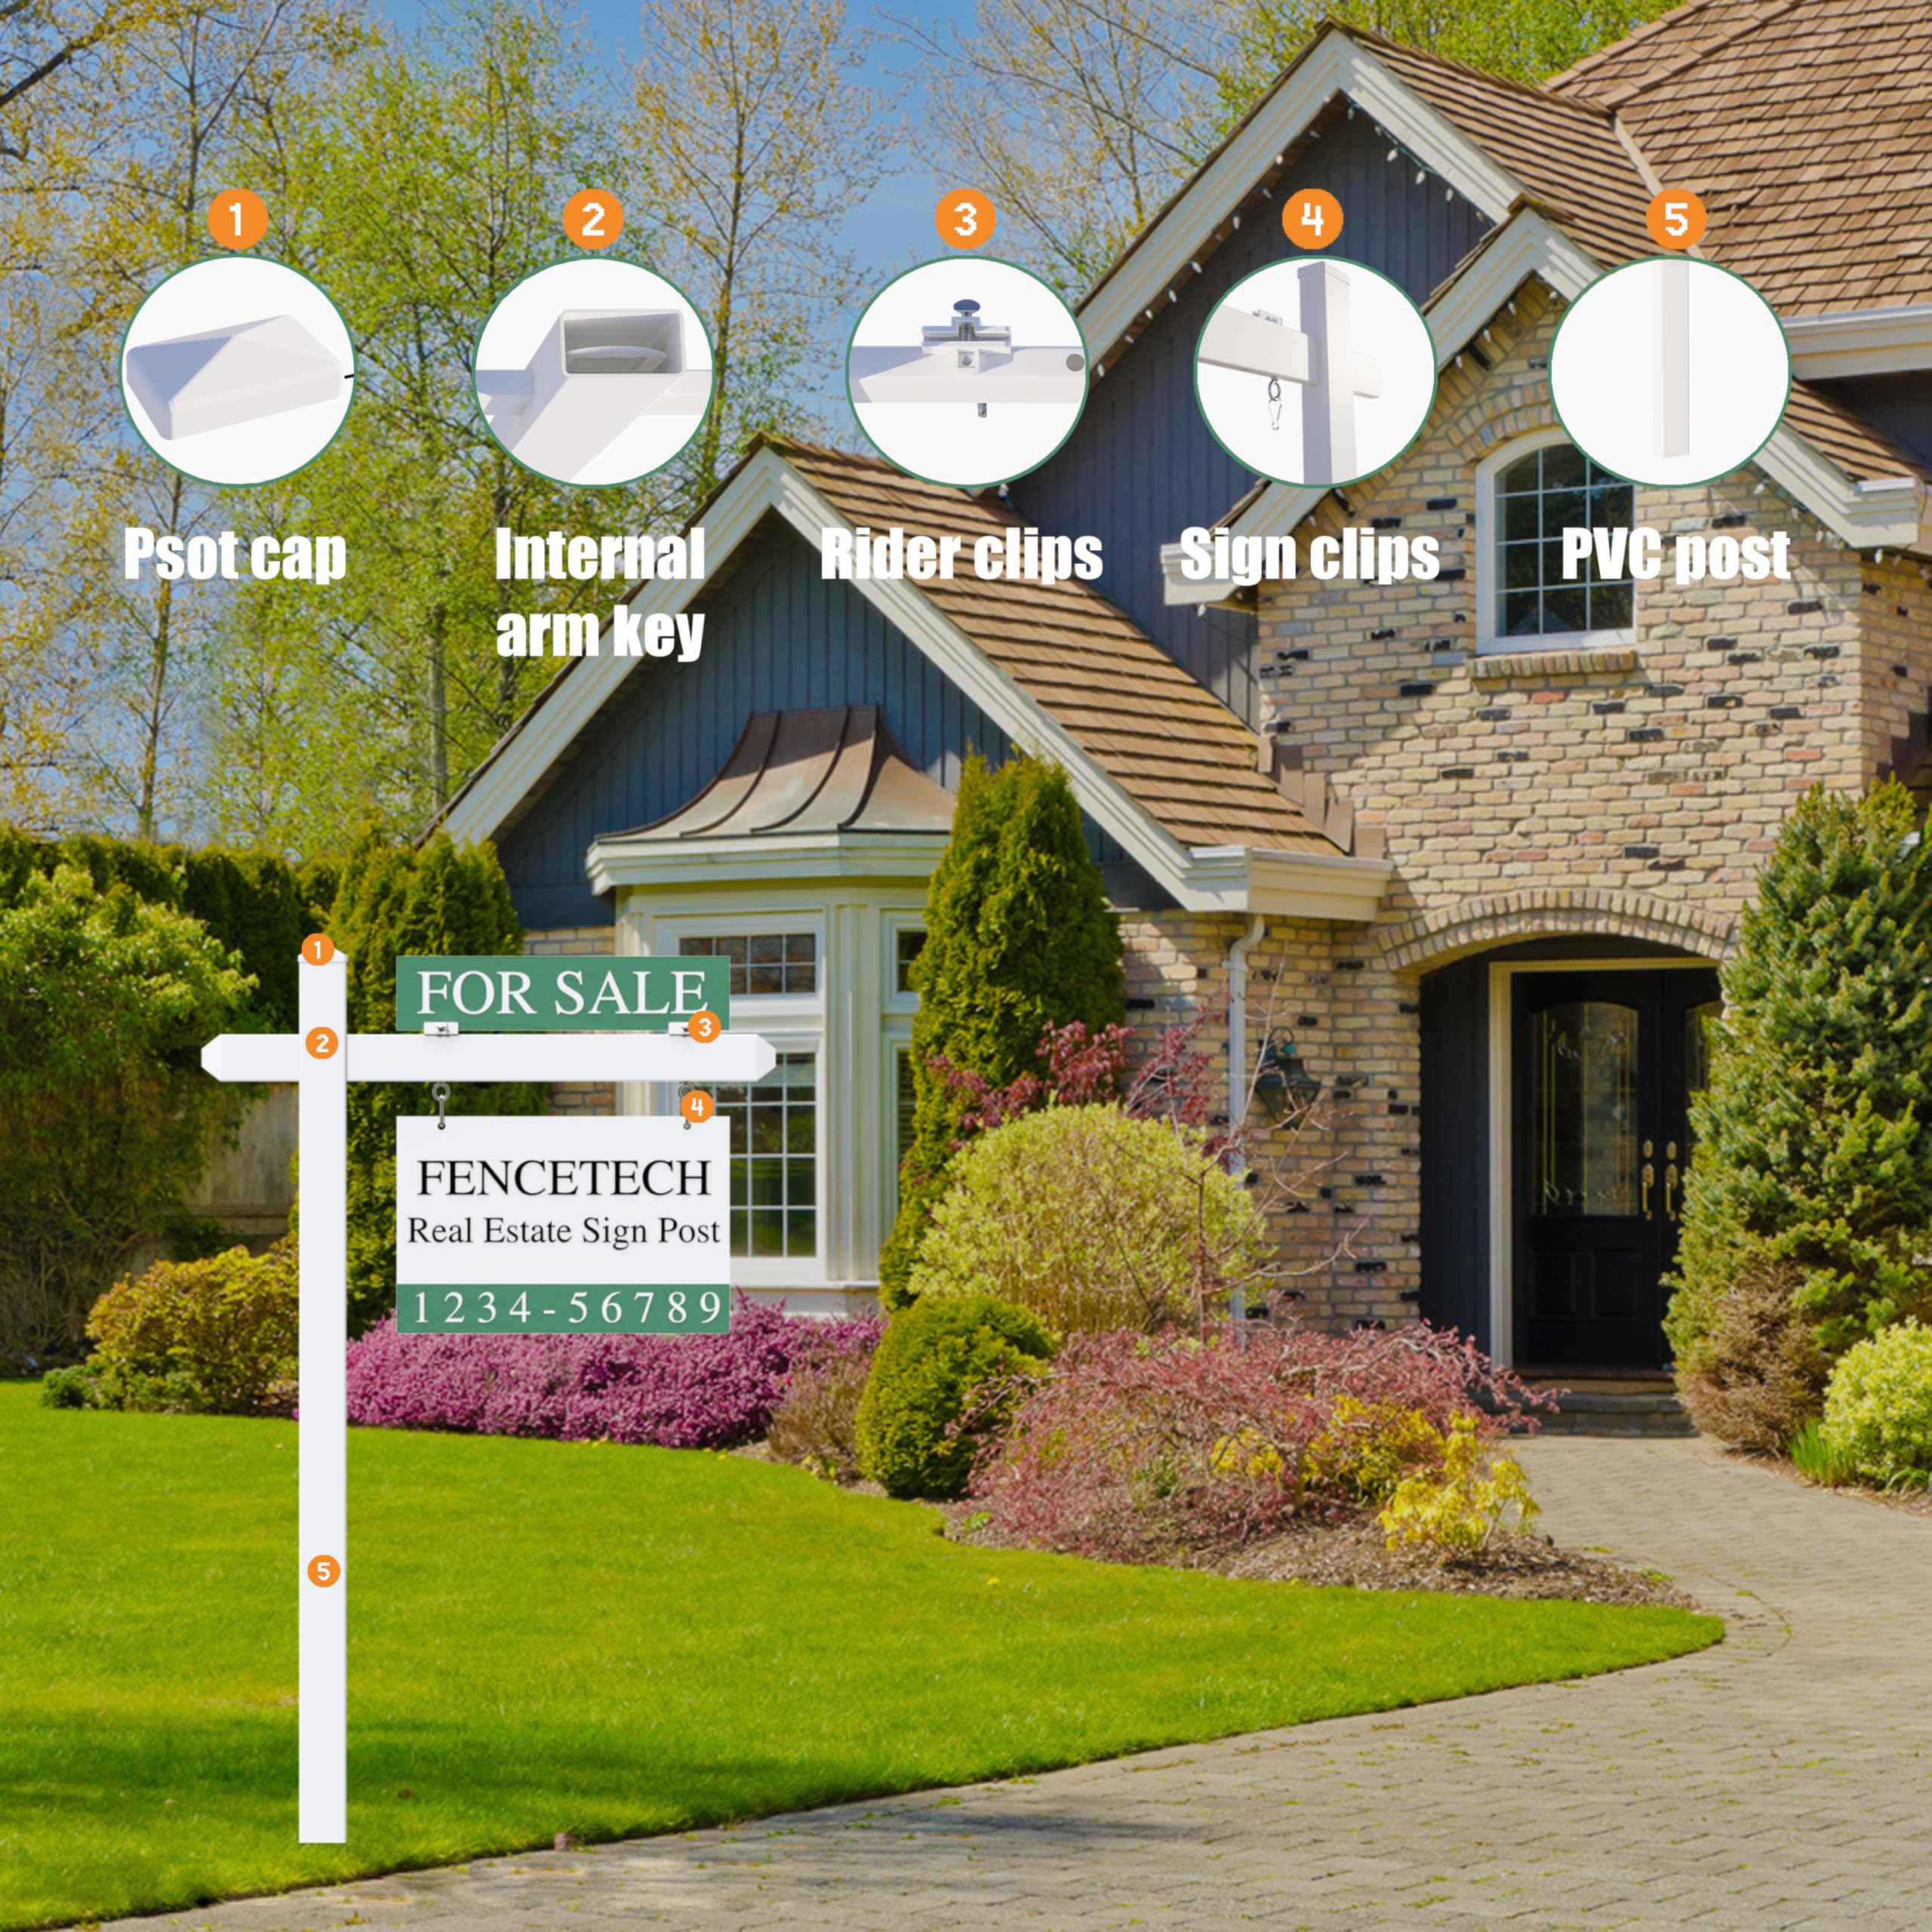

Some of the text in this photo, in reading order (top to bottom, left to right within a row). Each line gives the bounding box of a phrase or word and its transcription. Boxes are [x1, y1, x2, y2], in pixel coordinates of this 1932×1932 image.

[417, 971, 709, 1016] FOR SALE
[417, 1159, 711, 1196] FENCETECH
[408, 1216, 721, 1250] Real Estate Sign Post
